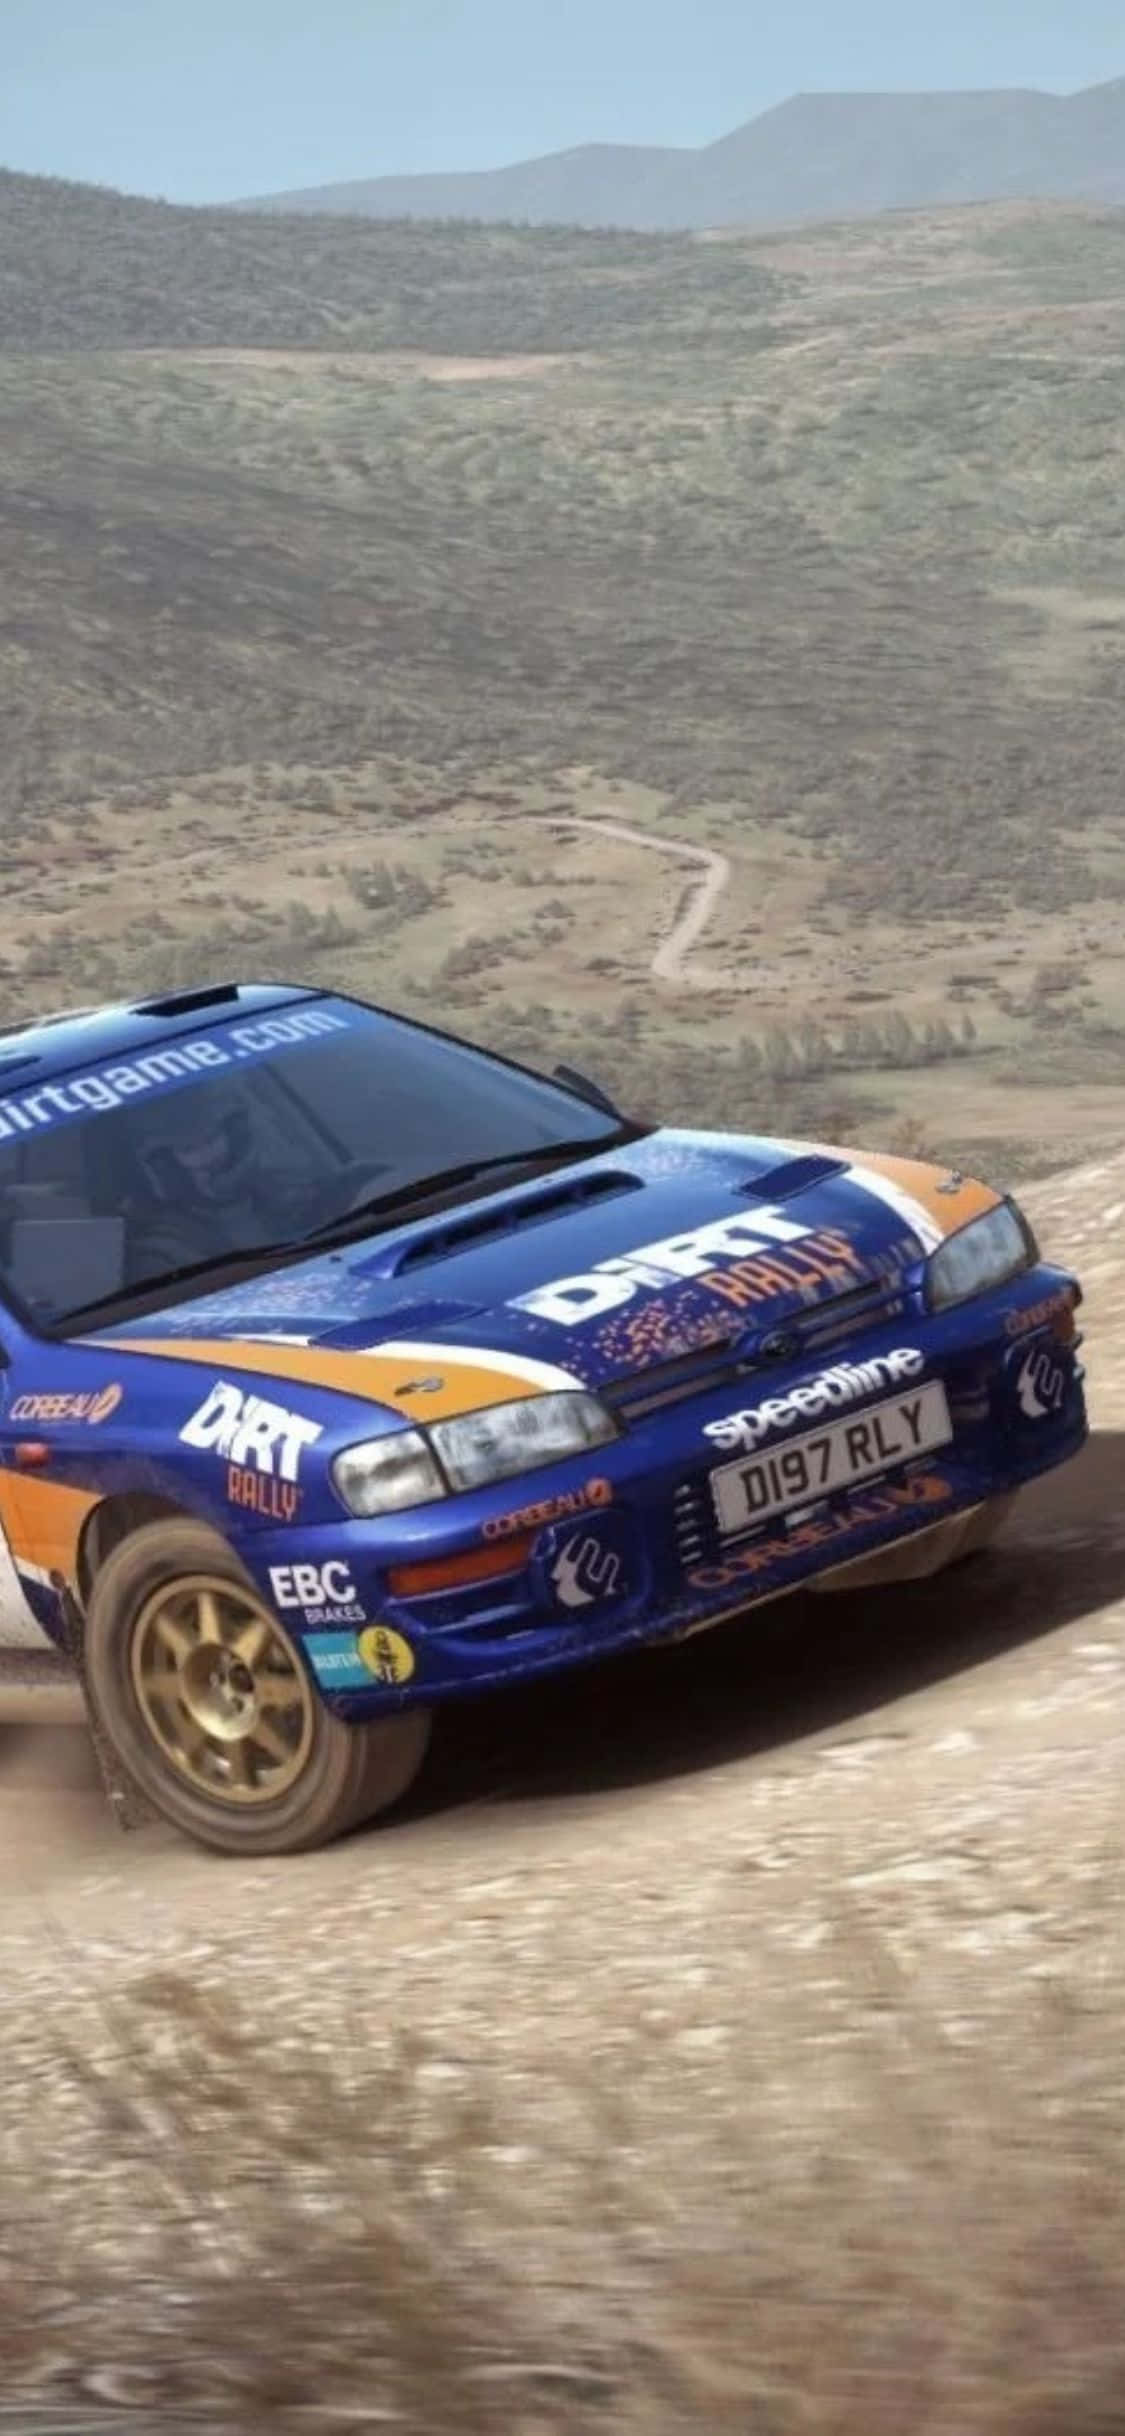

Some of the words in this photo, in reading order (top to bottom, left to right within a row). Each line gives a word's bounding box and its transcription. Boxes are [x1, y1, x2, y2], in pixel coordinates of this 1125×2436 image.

[697, 1231, 864, 1308] RALLY
[702, 1347, 925, 1450] speedline
[740, 1438, 832, 1513] D197
[845, 1399, 922, 1470] RLY
[228, 1465, 297, 1522] RALLY
[268, 1560, 356, 1608] EBC
[304, 1604, 367, 1625] BRAKES
